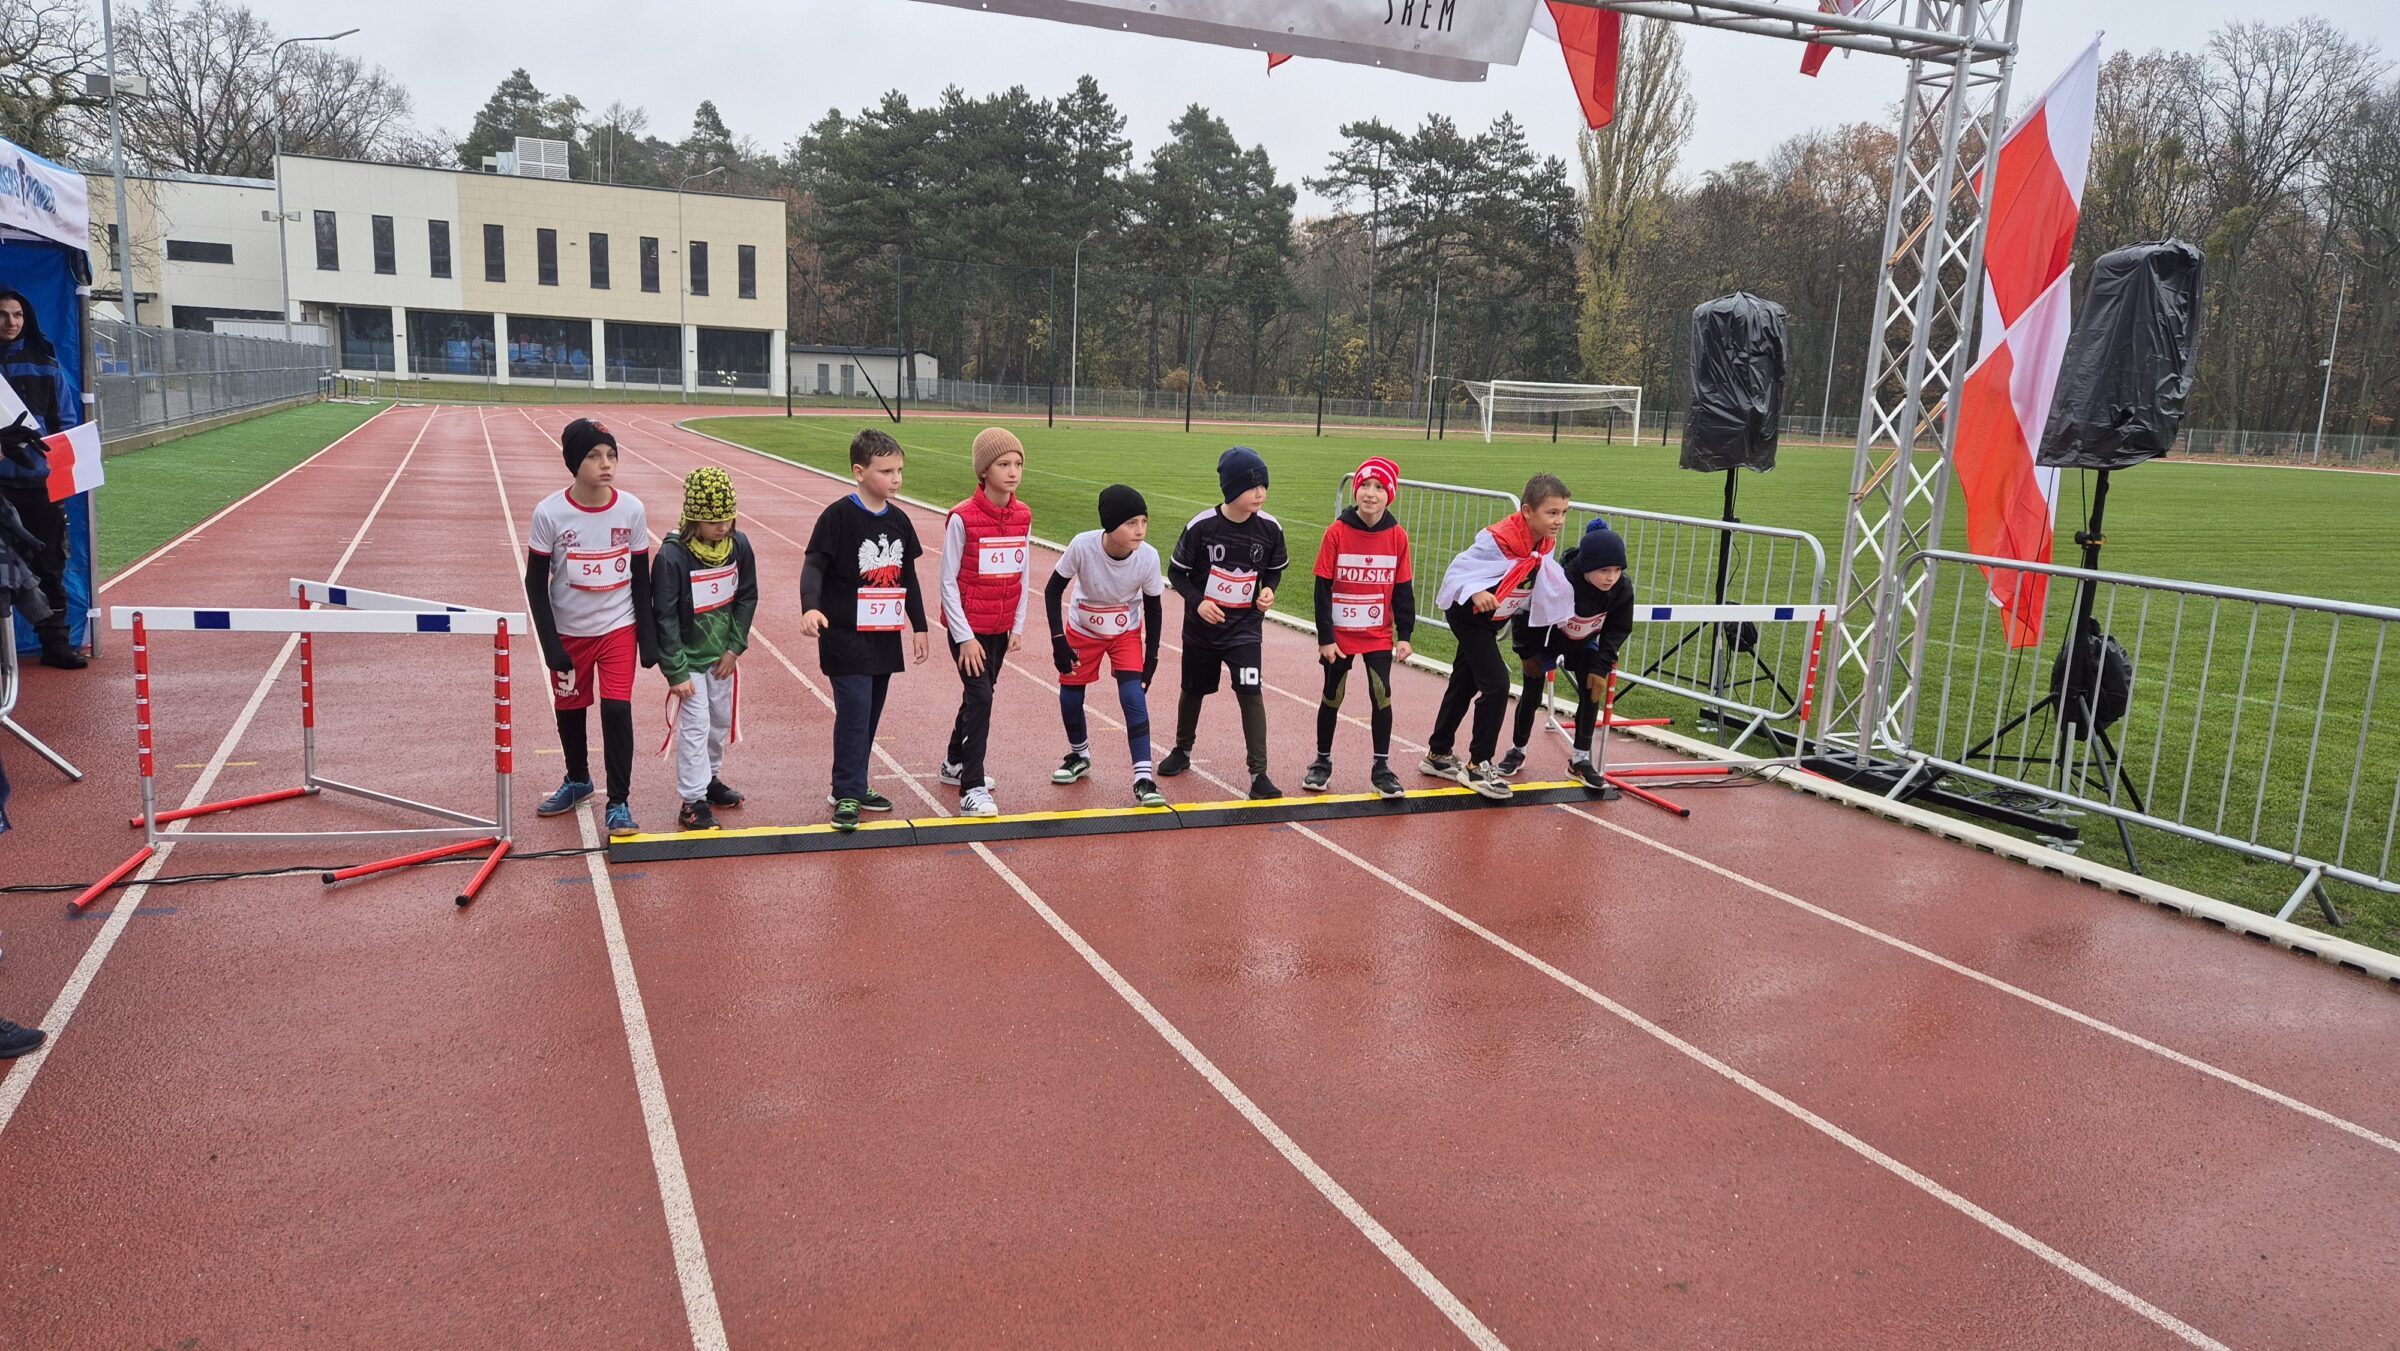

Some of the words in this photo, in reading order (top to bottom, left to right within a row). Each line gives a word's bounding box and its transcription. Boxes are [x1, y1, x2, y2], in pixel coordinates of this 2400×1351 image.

[990, 552, 1006, 564] 61
[1206, 544, 1226, 563] 10
[582, 563, 602, 576] 54
[1336, 567, 1395, 583] POLSKA
[710, 582, 719, 595] 3
[1217, 582, 1233, 594] 66
[870, 603, 886, 615] 57
[1342, 607, 1357, 618] 55
[1088, 615, 1104, 626] 60
[1566, 621, 1581, 632] 68
[1239, 667, 1259, 686] 10
